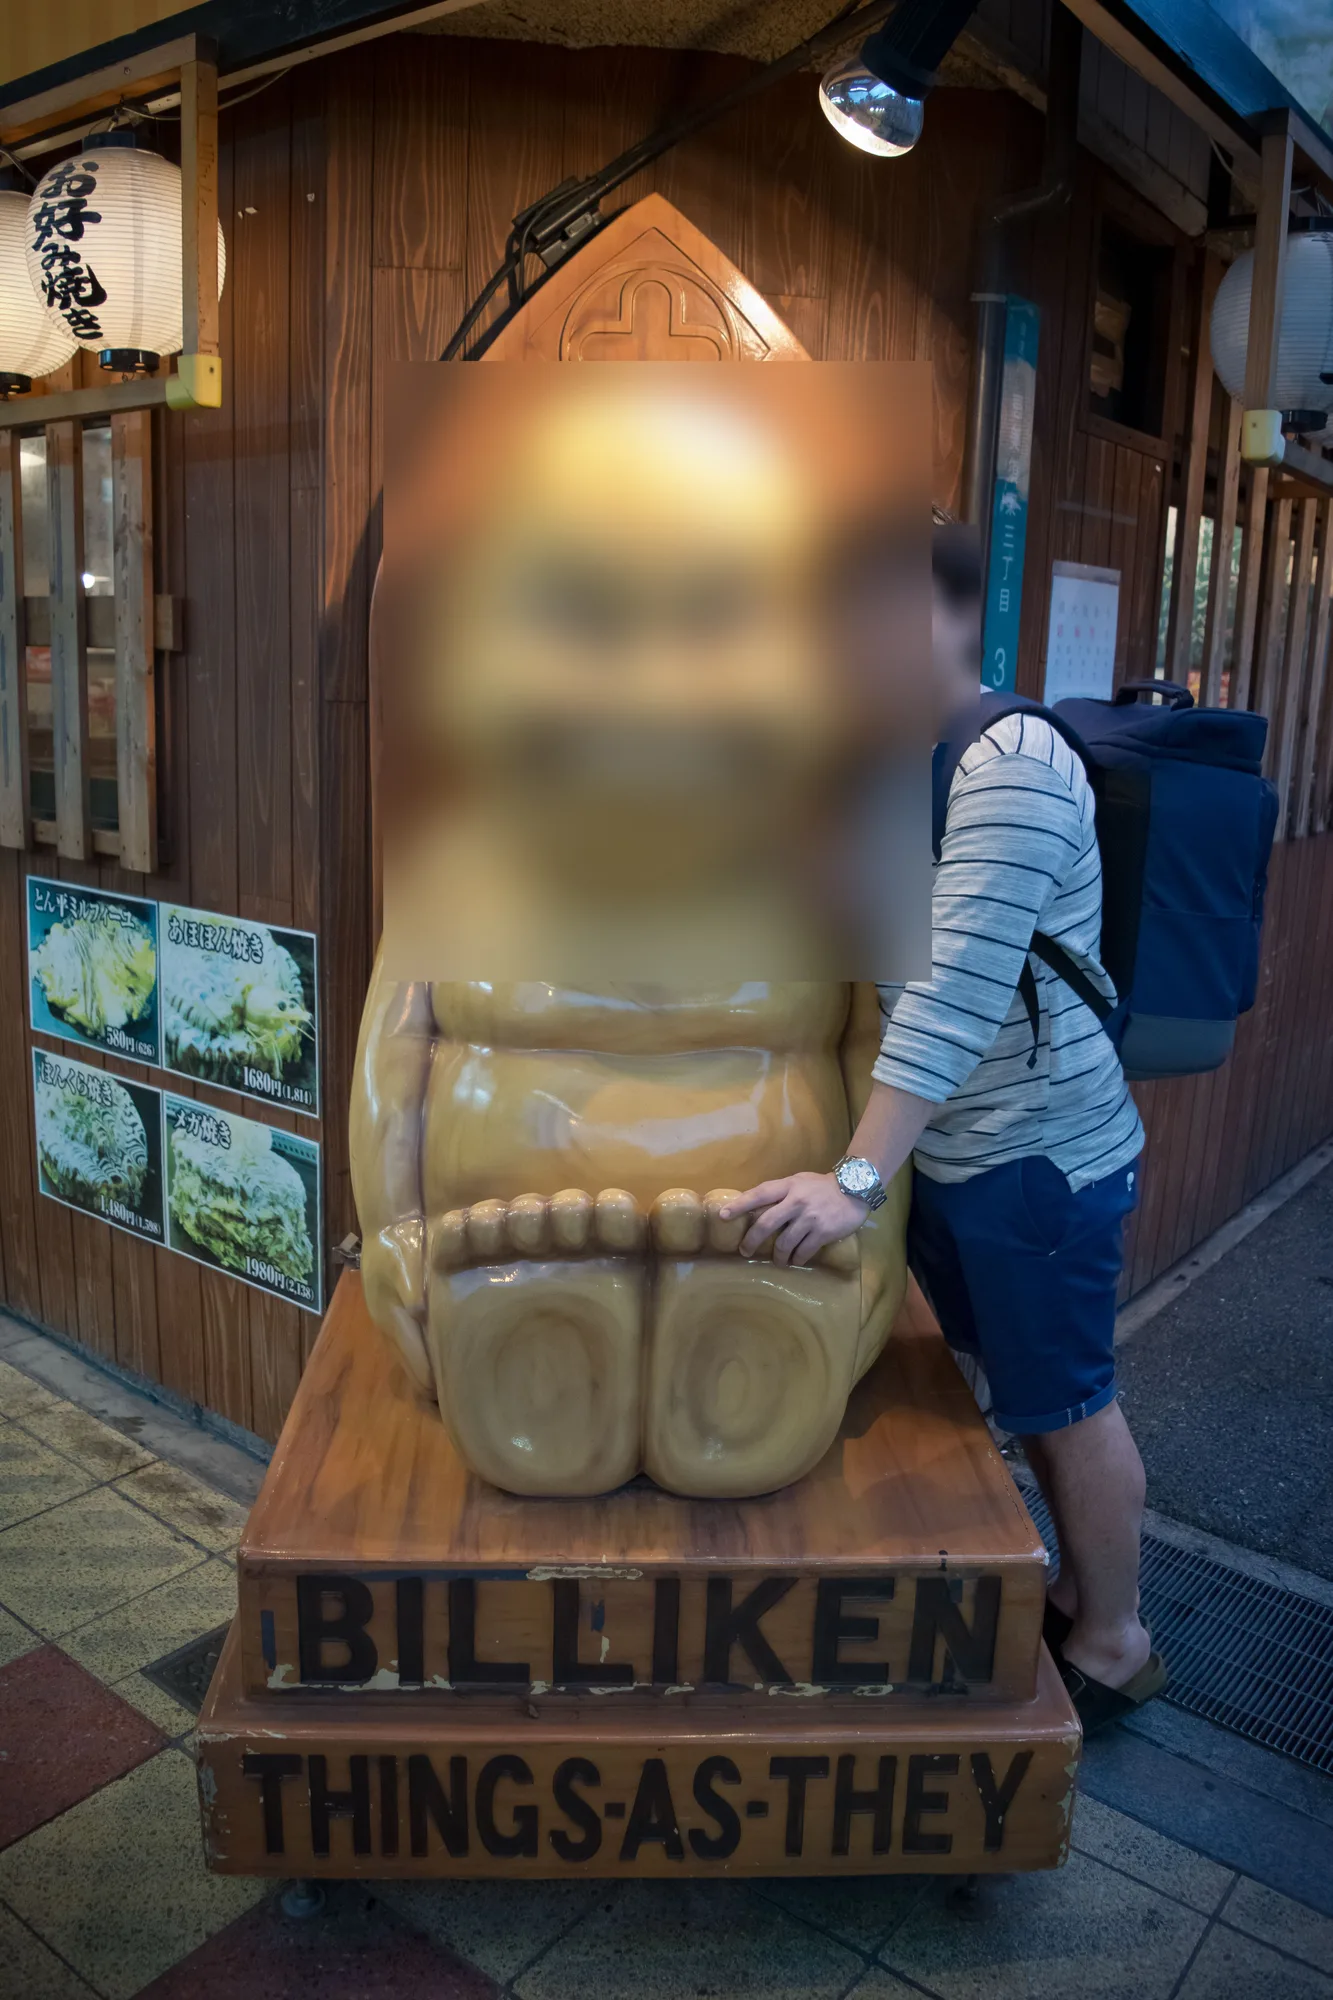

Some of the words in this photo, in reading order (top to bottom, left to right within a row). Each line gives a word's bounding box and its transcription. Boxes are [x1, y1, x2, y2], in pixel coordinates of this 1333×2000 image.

[32, 161, 107, 339] お好み焼き
[35, 887, 136, 929] とん平ミルフィーユ
[173, 1108, 232, 1150] メガ焼き
[296, 1575, 1000, 1685] BILLIKEN
